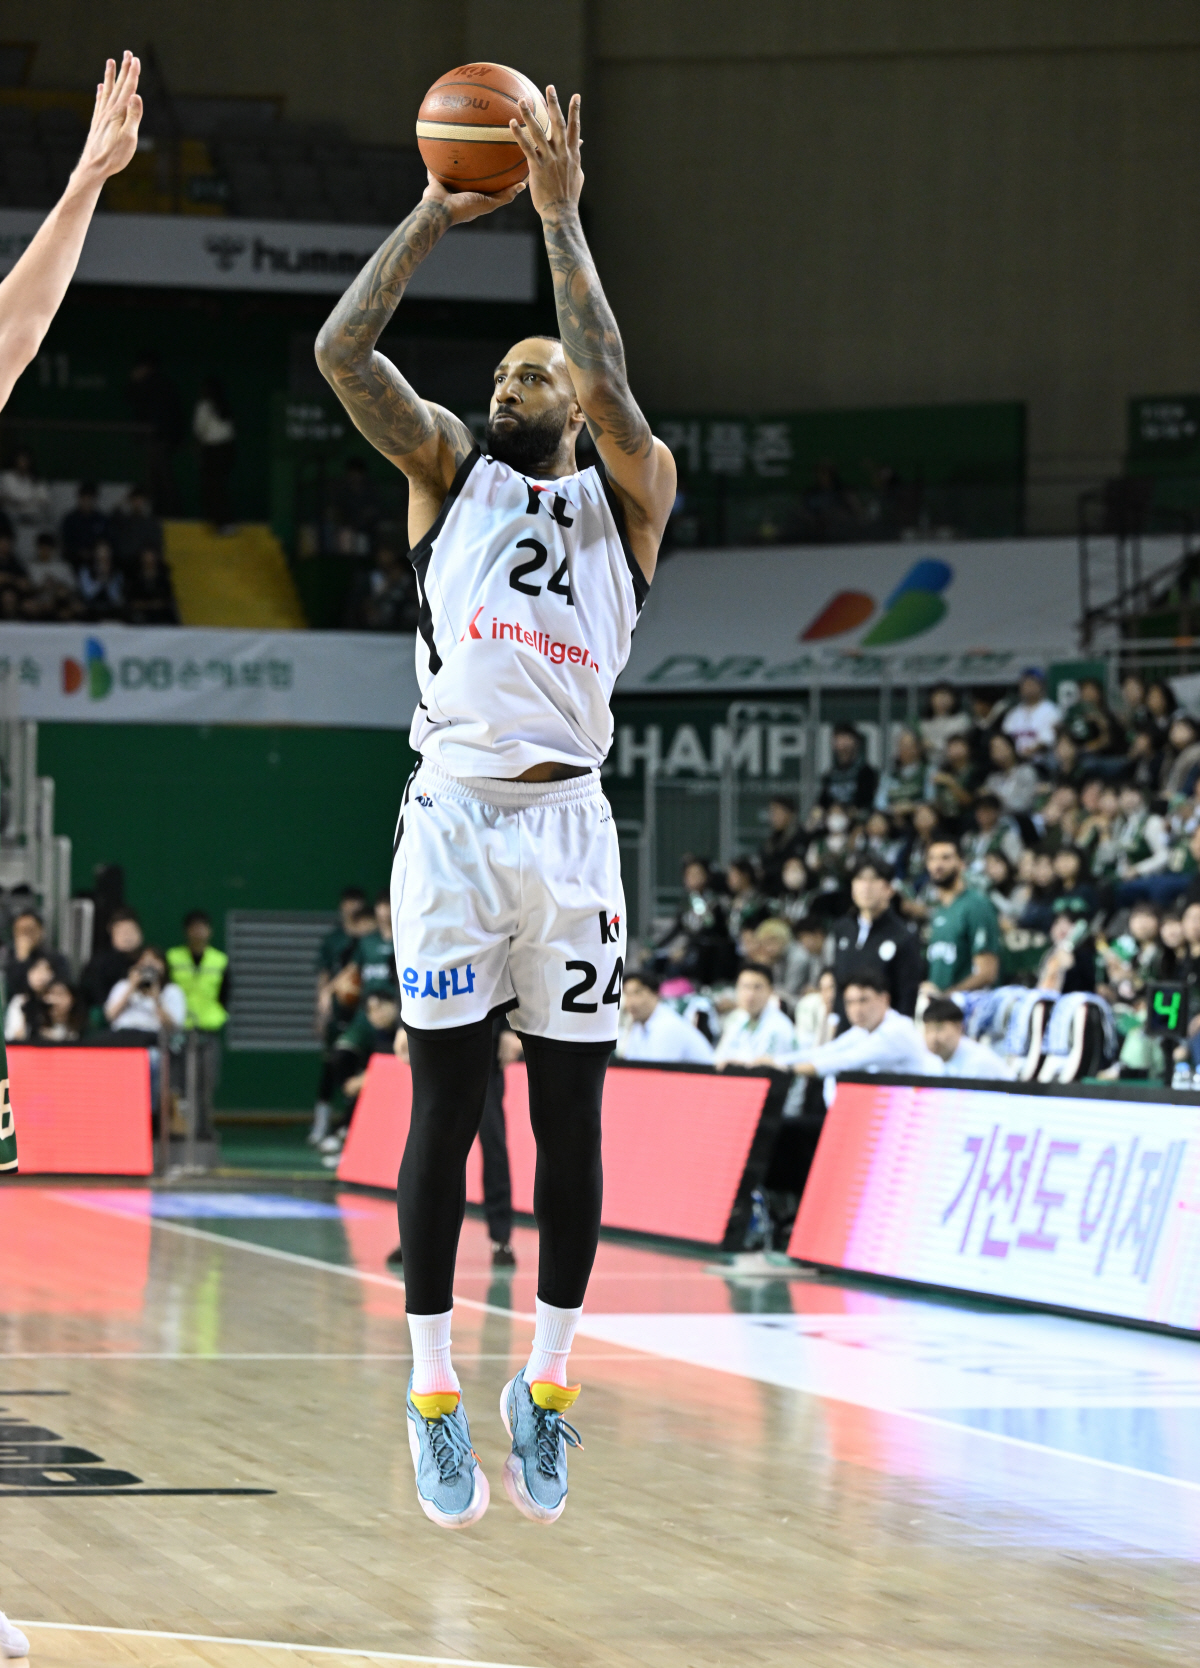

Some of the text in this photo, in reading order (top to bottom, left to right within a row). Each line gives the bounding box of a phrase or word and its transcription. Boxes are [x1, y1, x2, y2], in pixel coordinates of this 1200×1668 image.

[253, 235, 374, 274] humm
[509, 538, 575, 606] 24
[492, 617, 599, 674] intelligen
[402, 964, 476, 1000] 유사나
[561, 956, 624, 1013] 24
[1153, 991, 1181, 1029] 4
[941, 1124, 1187, 1284] 가전도 이제
